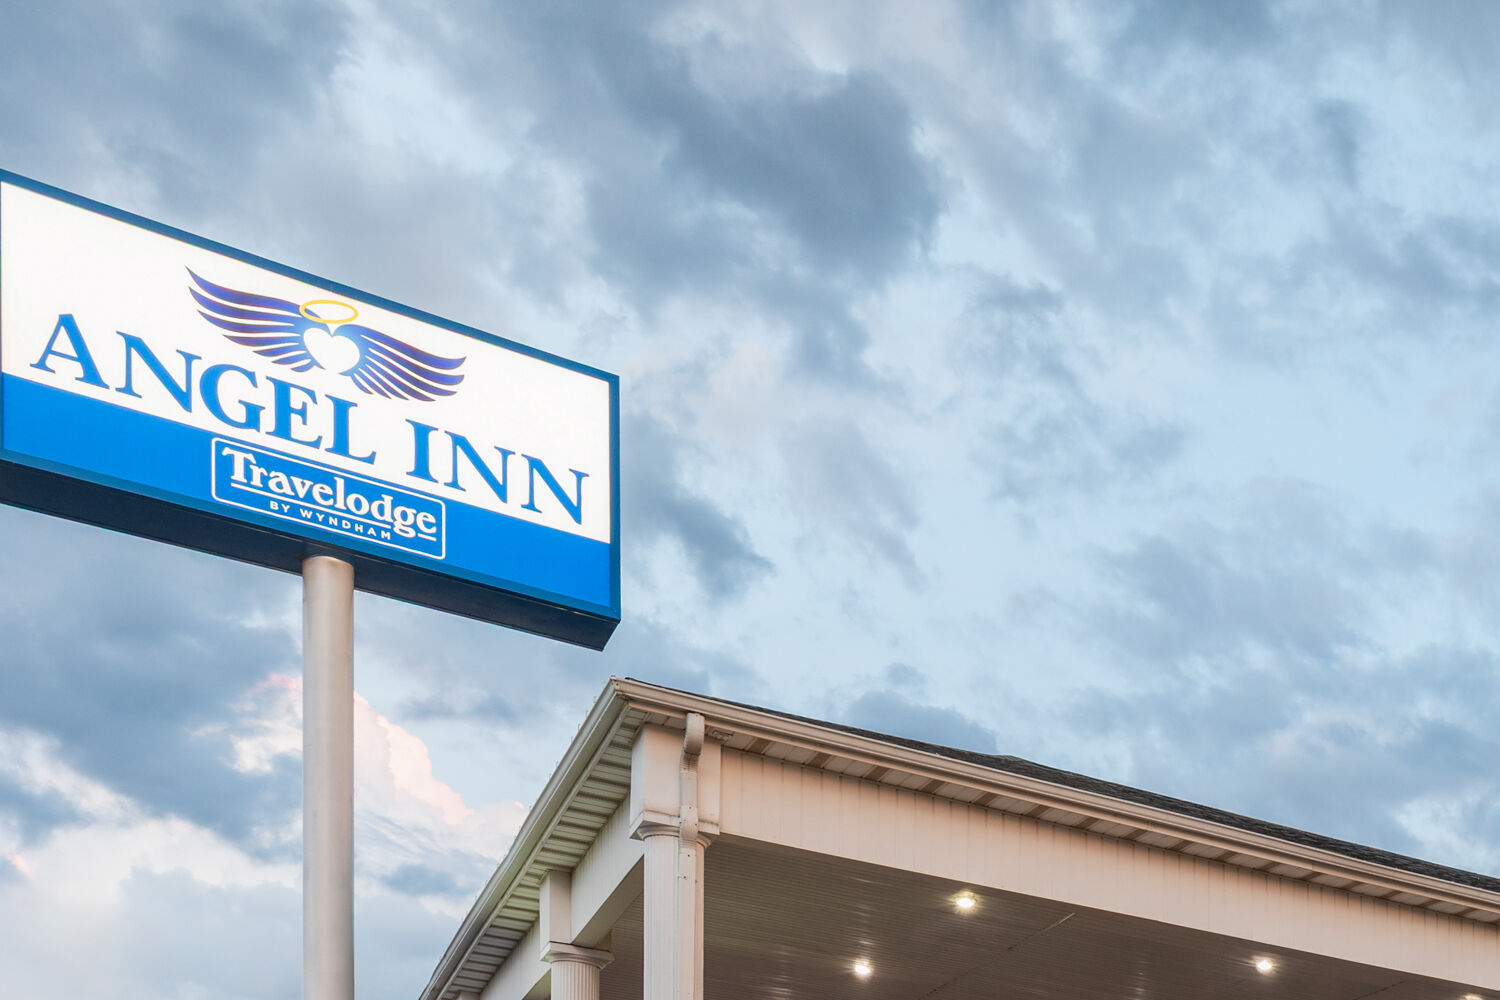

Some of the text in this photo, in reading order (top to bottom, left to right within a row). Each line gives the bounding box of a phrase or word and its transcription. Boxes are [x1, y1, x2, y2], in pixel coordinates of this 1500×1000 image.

[29, 313, 589, 525] ANGEL INN
[222, 447, 437, 538] Travelodge
[269, 500, 391, 540] BY WYNDHAM
